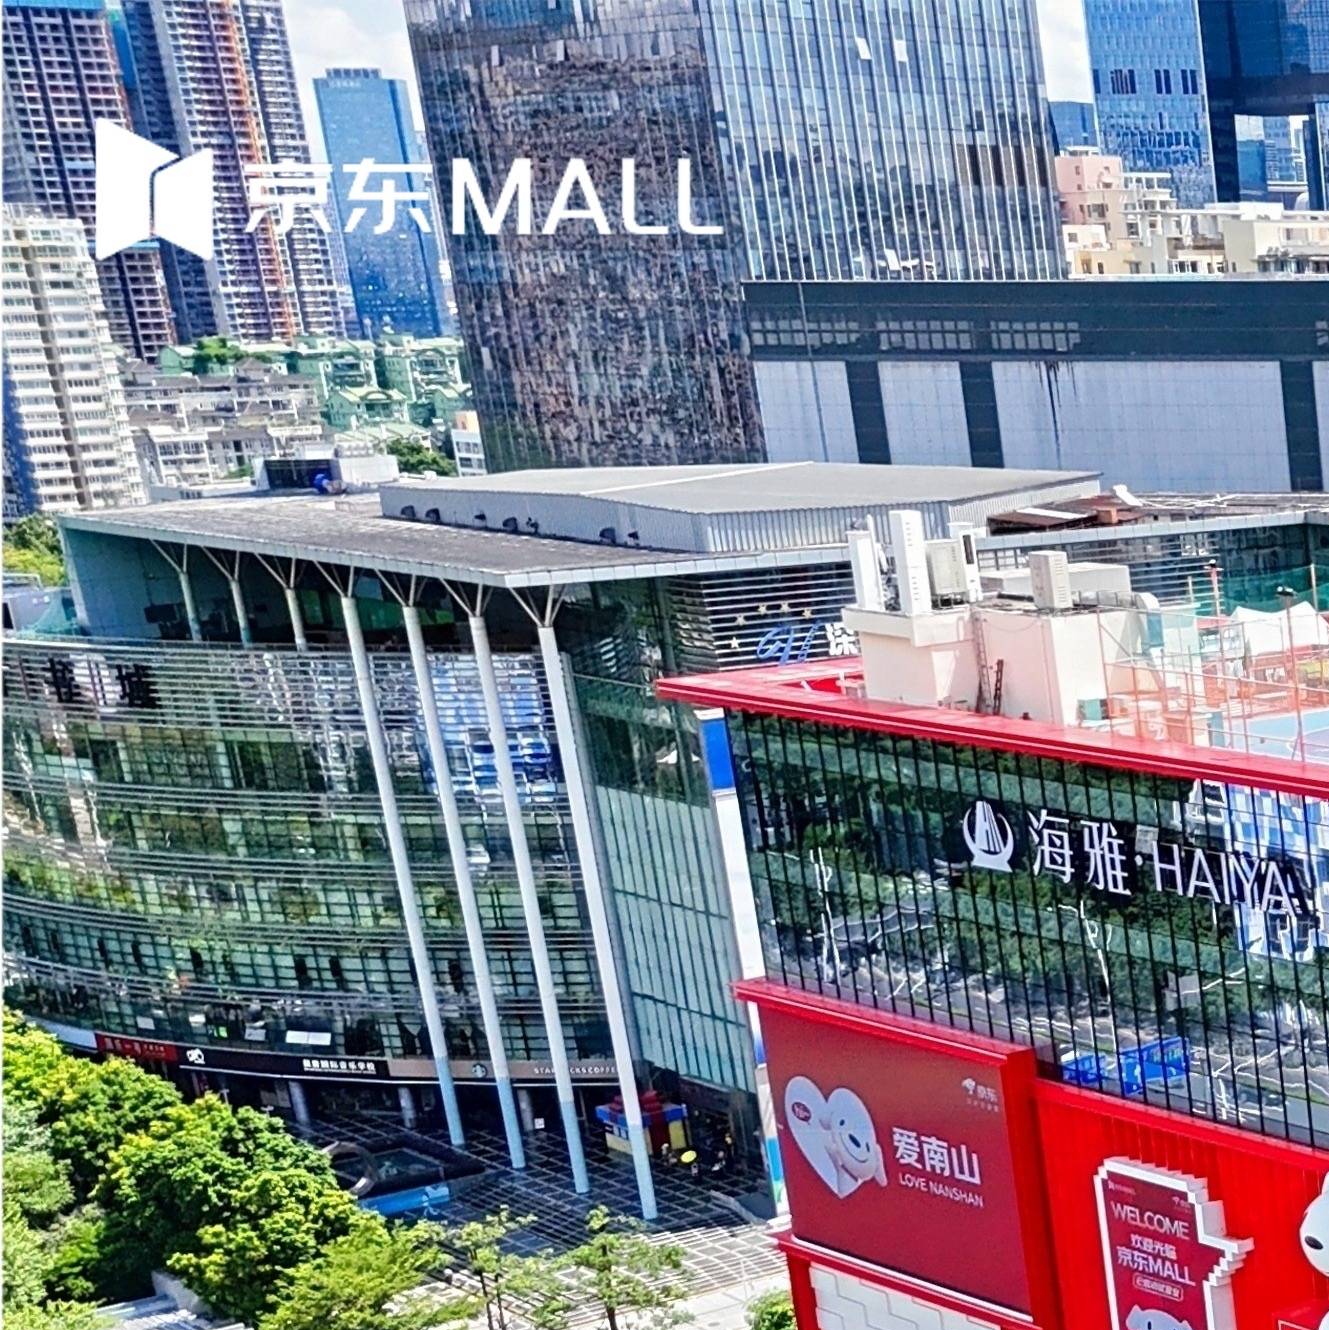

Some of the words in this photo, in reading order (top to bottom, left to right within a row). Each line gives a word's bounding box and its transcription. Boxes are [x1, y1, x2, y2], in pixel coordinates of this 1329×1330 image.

[892, 1126, 982, 1185] 爱南山
[899, 1172, 928, 1192] LOVE
[929, 1180, 984, 1208] NANSHAN
[1110, 1200, 1191, 1240] WELCOME
[1116, 1245, 1197, 1287] 京东MALL
